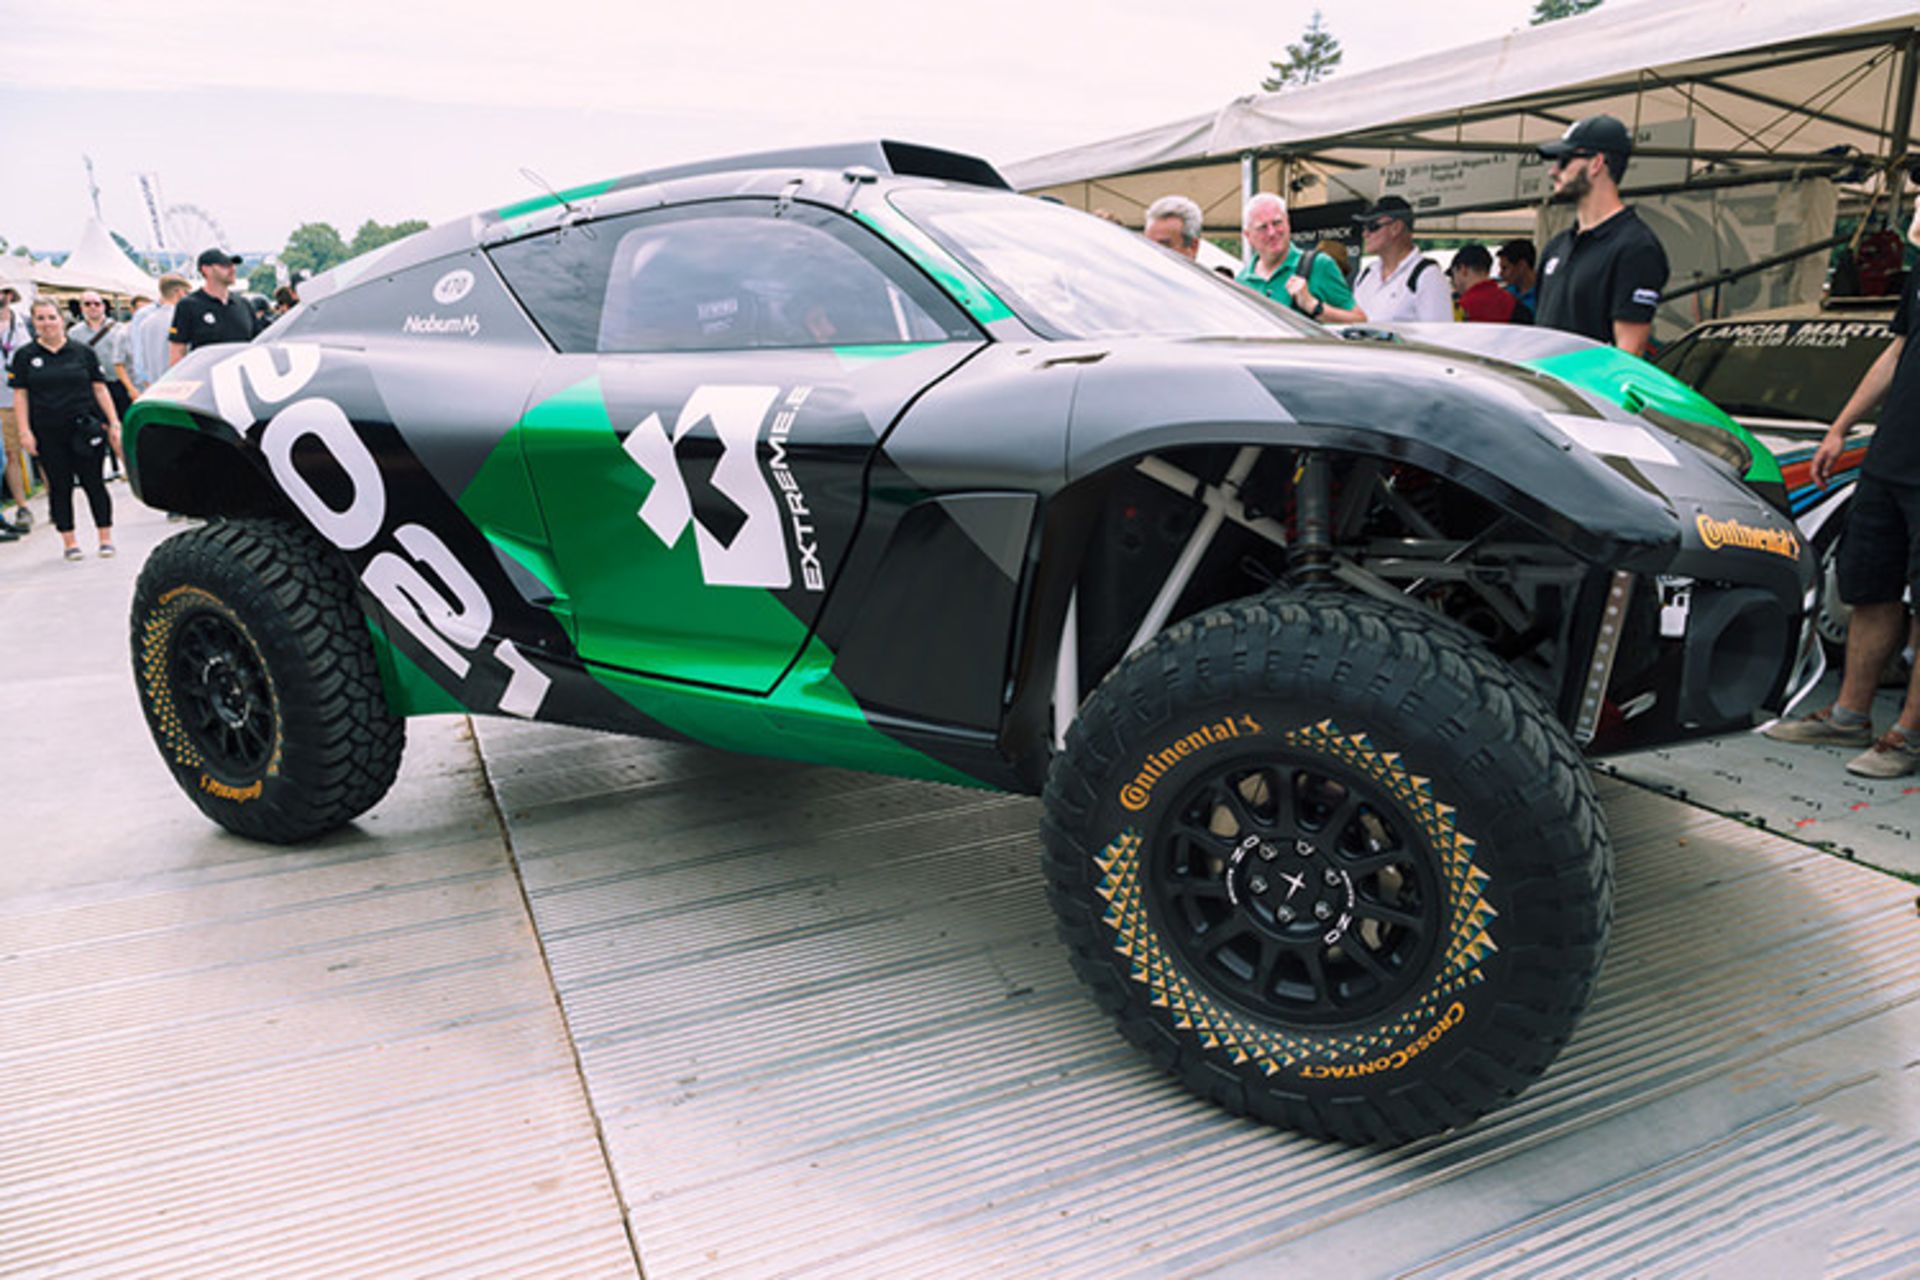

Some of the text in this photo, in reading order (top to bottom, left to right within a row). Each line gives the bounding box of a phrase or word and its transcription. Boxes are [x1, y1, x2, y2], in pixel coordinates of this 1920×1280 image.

[1699, 322, 1896, 340] LANCIA MARTI
[1733, 334, 1848, 347] CLUB ITALIA
[767, 384, 826, 592] EXTREME.E
[1120, 714, 1239, 811] Continental
